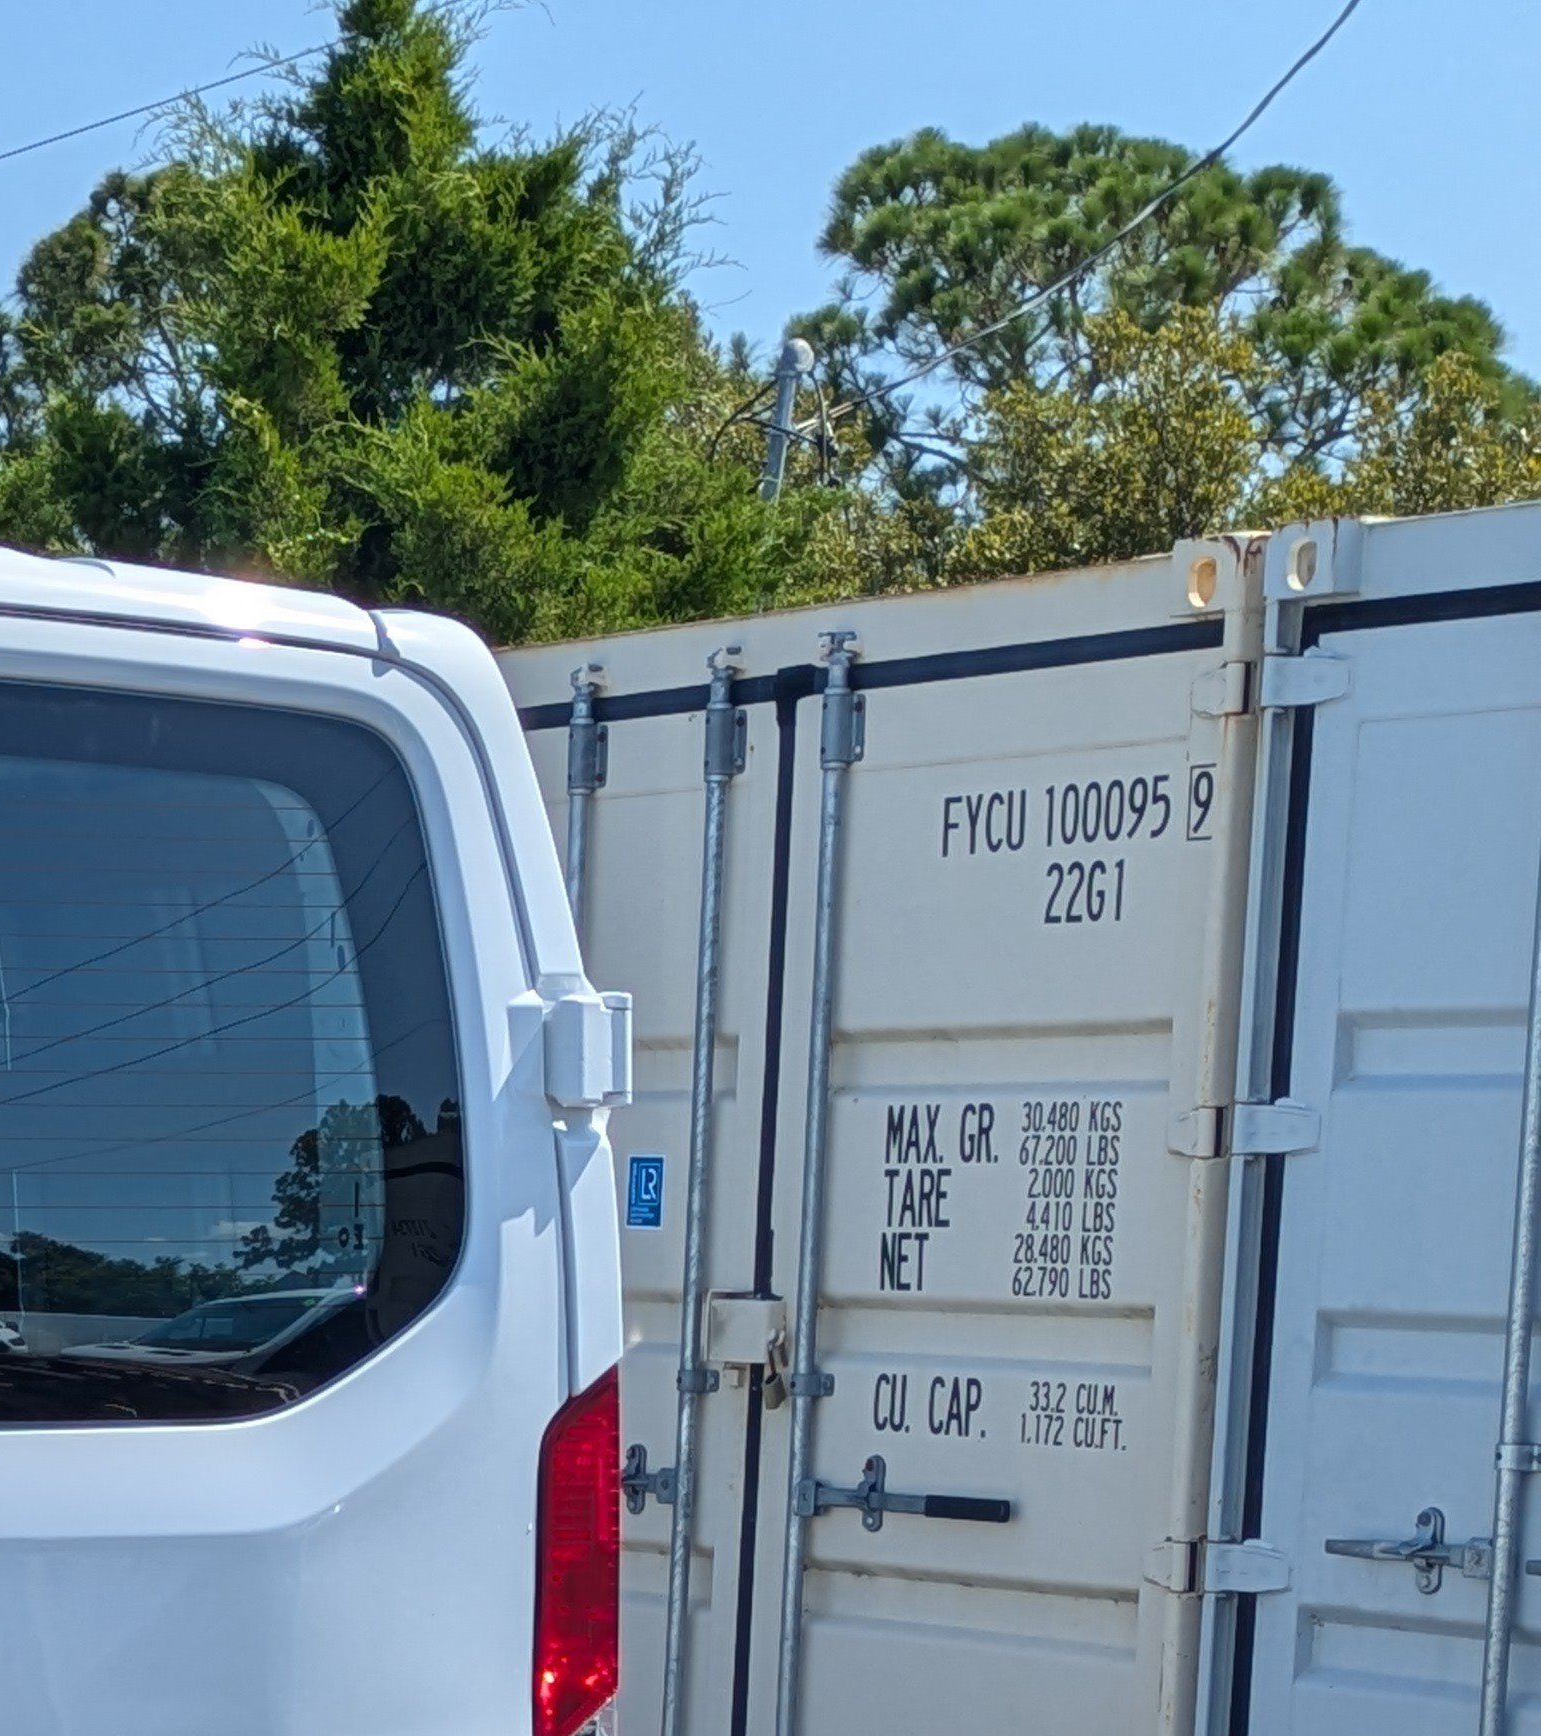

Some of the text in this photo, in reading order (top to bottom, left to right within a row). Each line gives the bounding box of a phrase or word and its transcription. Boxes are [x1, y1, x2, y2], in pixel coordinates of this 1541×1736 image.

[941, 771, 1214, 857] FYCU 100095 9
[1044, 858, 1125, 924] 22G1
[885, 1104, 944, 1164] MAX.
[960, 1103, 999, 1164] GR.
[1088, 1101, 1123, 1133] KGS
[1086, 1135, 1121, 1166] LBS
[884, 1168, 952, 1227] TARE
[1083, 1168, 1119, 1200] KGS
[1081, 1202, 1116, 1233] LBS
[880, 1232, 929, 1291] NET
[1079, 1235, 1114, 1267] KGS
[1078, 1268, 1112, 1300] LBS
[873, 1373, 910, 1433] CU.
[928, 1376, 986, 1438] CAP.
[1029, 1381, 1067, 1413] 33.2
